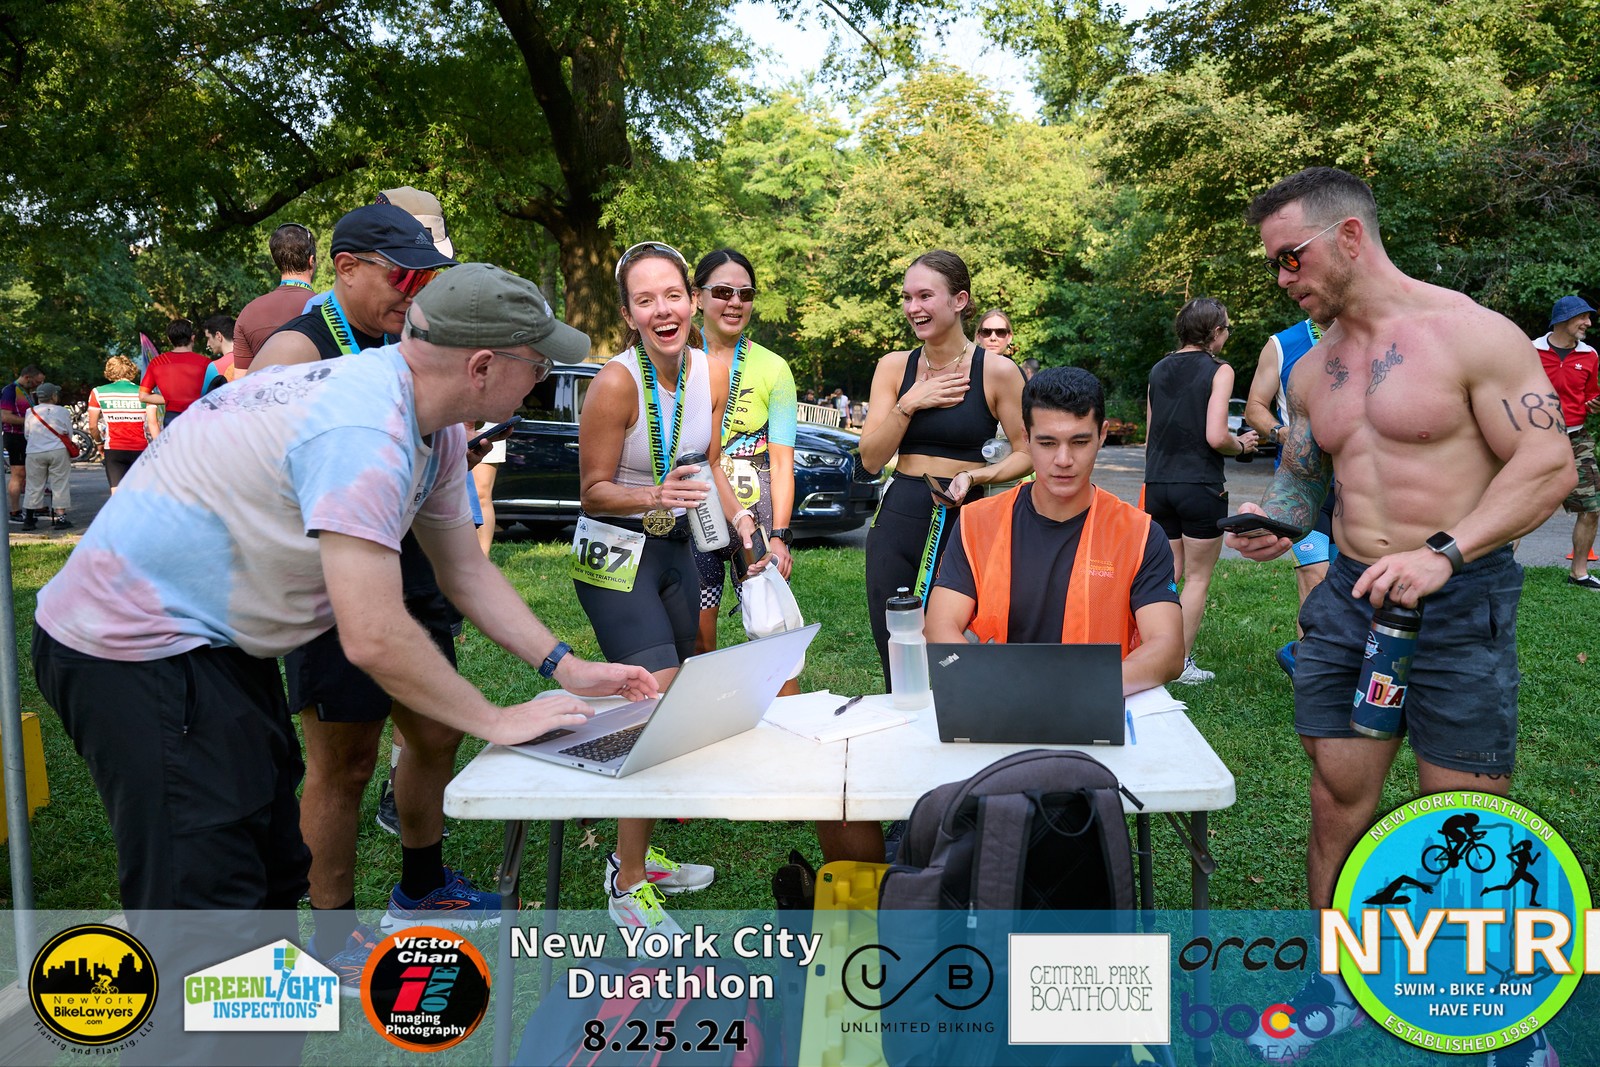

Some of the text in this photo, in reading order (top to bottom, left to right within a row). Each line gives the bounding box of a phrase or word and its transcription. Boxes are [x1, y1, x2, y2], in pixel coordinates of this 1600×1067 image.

[737, 347, 746, 362] NY
[648, 402, 659, 418] NY
[726, 371, 743, 416] TRIATHLON
[669, 402, 683, 459] TRIATHLON
[723, 415, 732, 430] NY
[650, 417, 666, 477] TRIATHLON
[697, 502, 719, 544] AMELBAK
[579, 538, 632, 573] 187
[925, 520, 942, 572] TRIATHLON
[595, 573, 627, 584] TRIATHLON
[919, 581, 927, 597] NY
